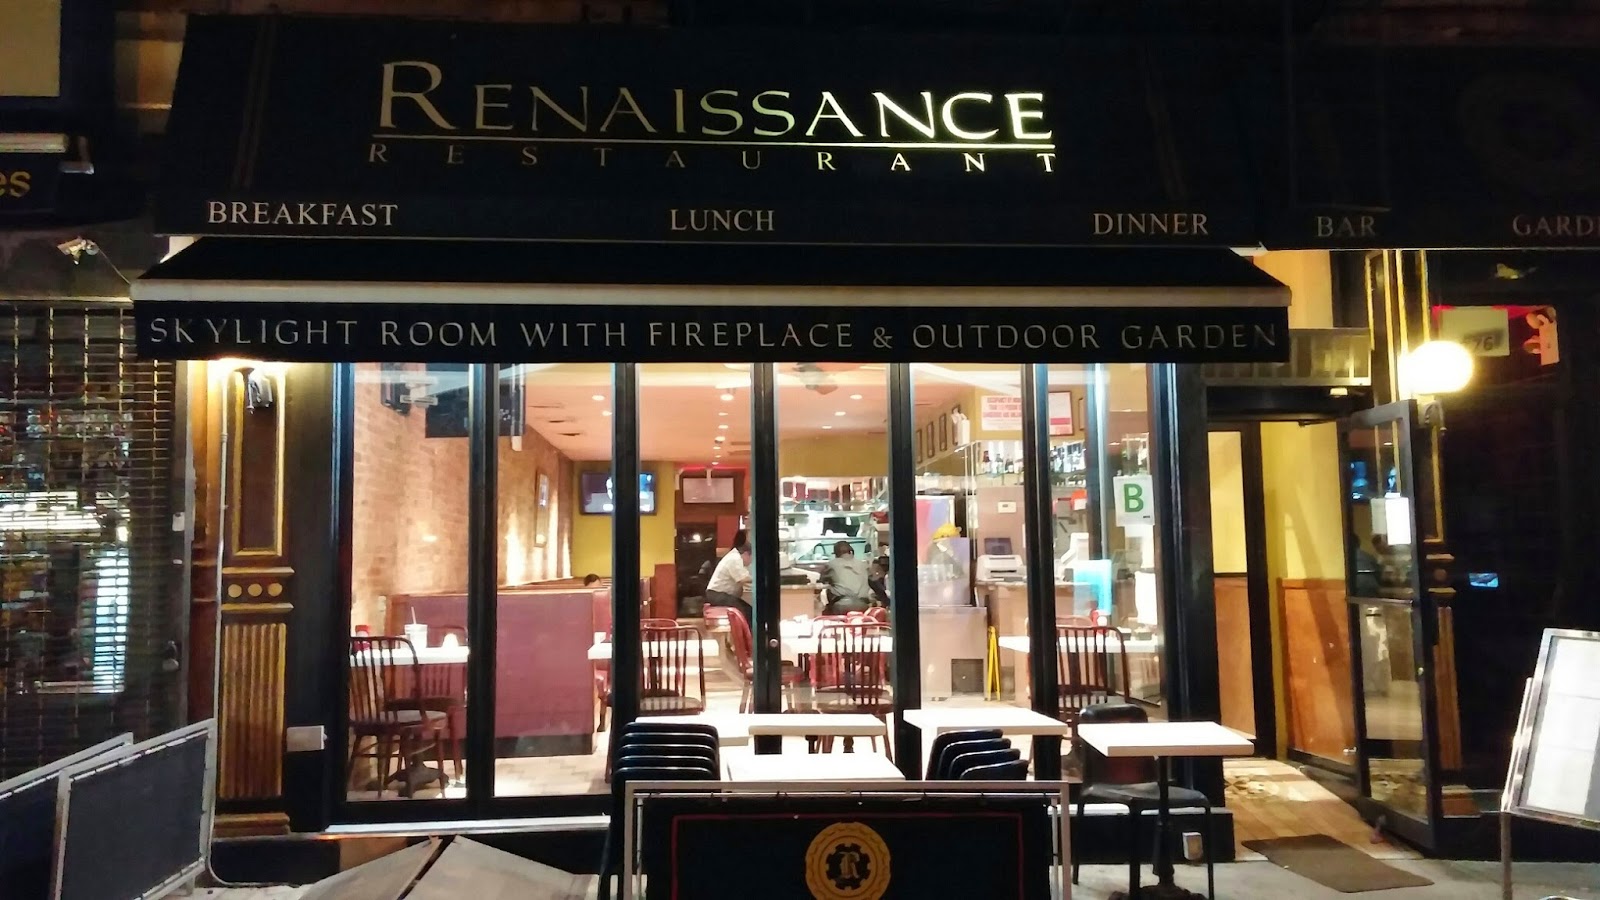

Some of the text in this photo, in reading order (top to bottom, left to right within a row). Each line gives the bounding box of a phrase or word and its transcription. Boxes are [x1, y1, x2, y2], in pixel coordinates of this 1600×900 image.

[379, 60, 1053, 139] RENAISSANCE
[368, 143, 1057, 173] RESTAURANT
[208, 202, 398, 226] BREAKFAST
[670, 209, 776, 232] LUNCH
[1093, 213, 1209, 236] DINNER
[1512, 214, 1600, 237] GARD
[1316, 215, 1377, 238] BAR
[149, 318, 1278, 350] SKYLIGHT ROOM WITH FIREPLACE & OUTDOOR GARDEN
[1123, 483, 1144, 513] B
